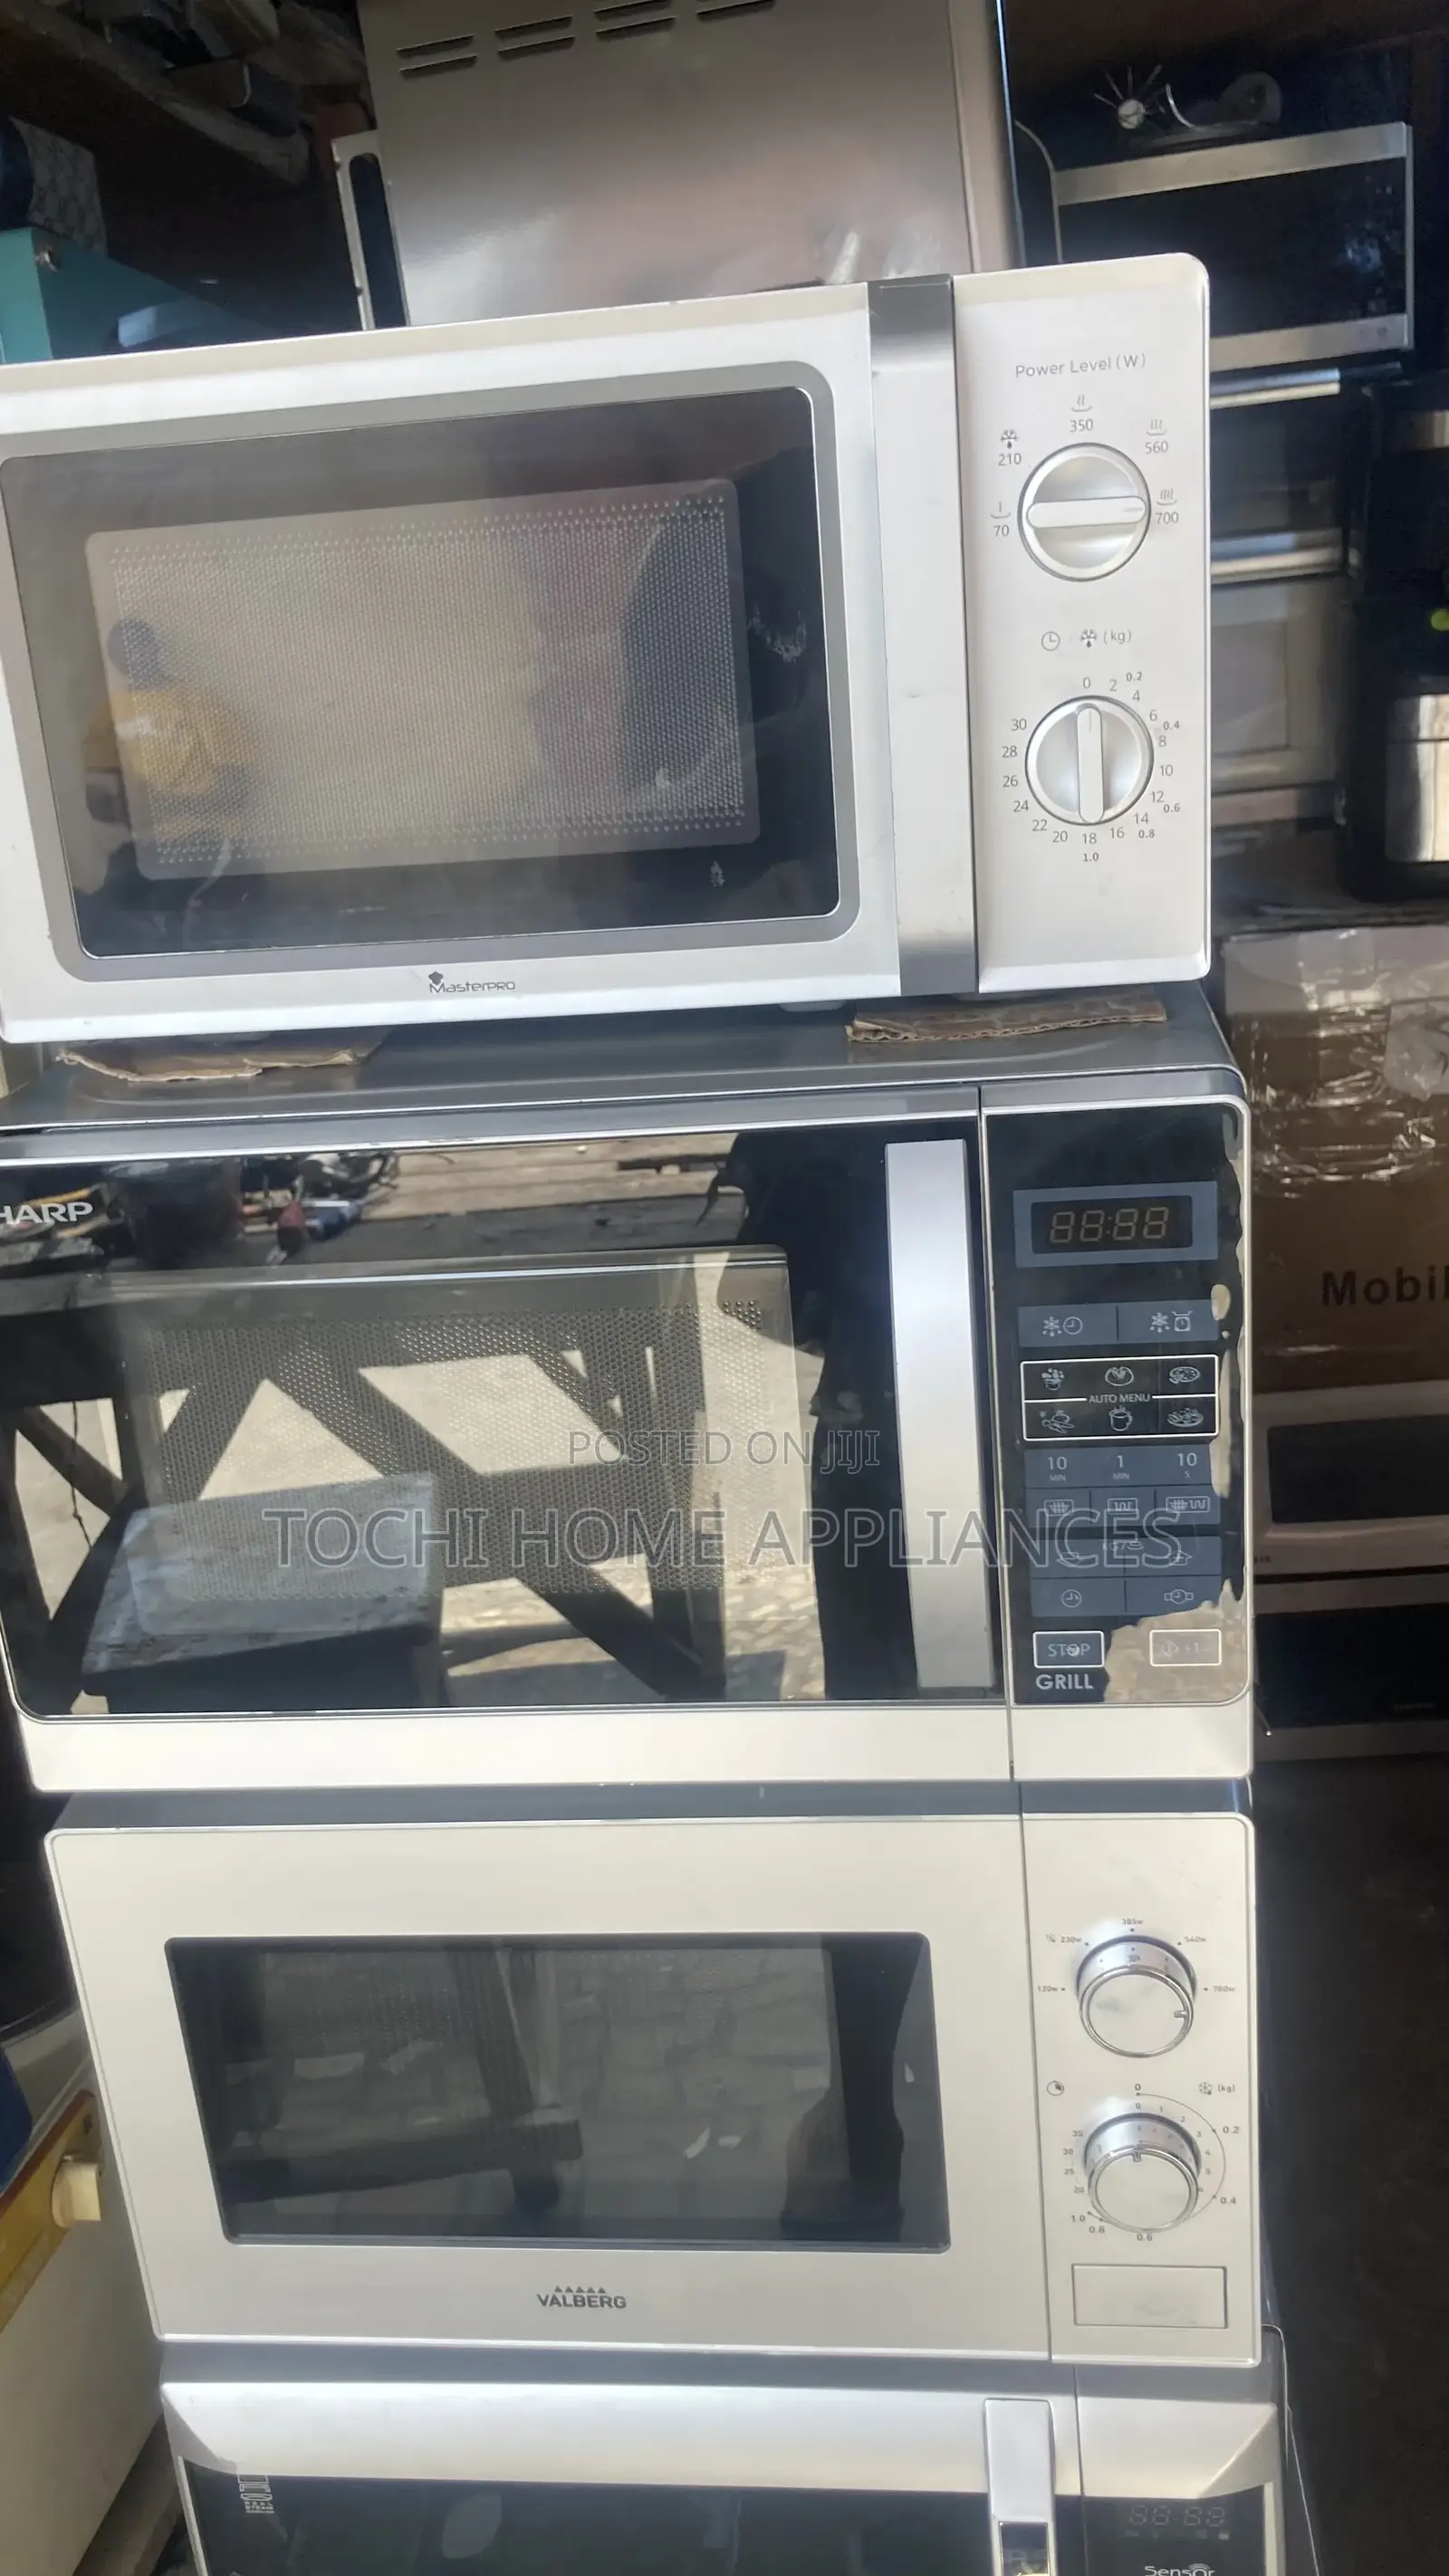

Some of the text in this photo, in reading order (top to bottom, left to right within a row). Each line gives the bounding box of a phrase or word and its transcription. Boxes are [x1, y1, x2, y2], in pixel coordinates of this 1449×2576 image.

[1015, 353, 1147, 378] Power Level (W)
[1070, 418, 1094, 433] 350
[1145, 440, 1169, 455] 560
[998, 453, 1022, 466] 210
[1155, 512, 1179, 525] 700
[993, 524, 1010, 538] 70
[1102, 629, 1132, 646] (kg)
[1082, 677, 1091, 689] 0
[1126, 672, 1143, 683] 0.2
[1109, 679, 1118, 692] 2
[1132, 690, 1141, 702] 4
[1149, 710, 1158, 722] 6
[1011, 719, 1027, 731] 30
[1163, 721, 1180, 731] 0.4
[1158, 735, 1167, 747] 8
[1002, 746, 1018, 758] 28
[1160, 764, 1174, 777] 10
[1003, 775, 1019, 787] 26
[1151, 791, 1165, 803] 12
[1013, 800, 1029, 812] 24
[1163, 803, 1181, 813] 0.6
[1134, 812, 1149, 824] 14
[1032, 819, 1048, 831] 22
[1052, 831, 1069, 843] 20
[1109, 827, 1125, 838] 16
[1138, 829, 1156, 839] 0.8
[1082, 833, 1098, 845] 18
[1083, 852, 1099, 862] 1.0
[1089, 1393, 1151, 1404] AUTO MENU
[1048, 1456, 1068, 1471] 10
[1116, 1455, 1125, 1469] 1
[1177, 1452, 1198, 1467] 10
[1049, 1474, 1067, 1482] MIN
[1112, 1472, 1130, 1480] MIN
[1035, 1672, 1095, 1690] GRILL
[1135, 2083, 1141, 2092] 0
[1223, 2126, 1240, 2134] 0.2
[1062, 2148, 1074, 2156] 30
[1220, 2197, 1236, 2205] 0.4
[1089, 2226, 1105, 2234] 0.8
[536, 2293, 628, 2310] VALBERG
